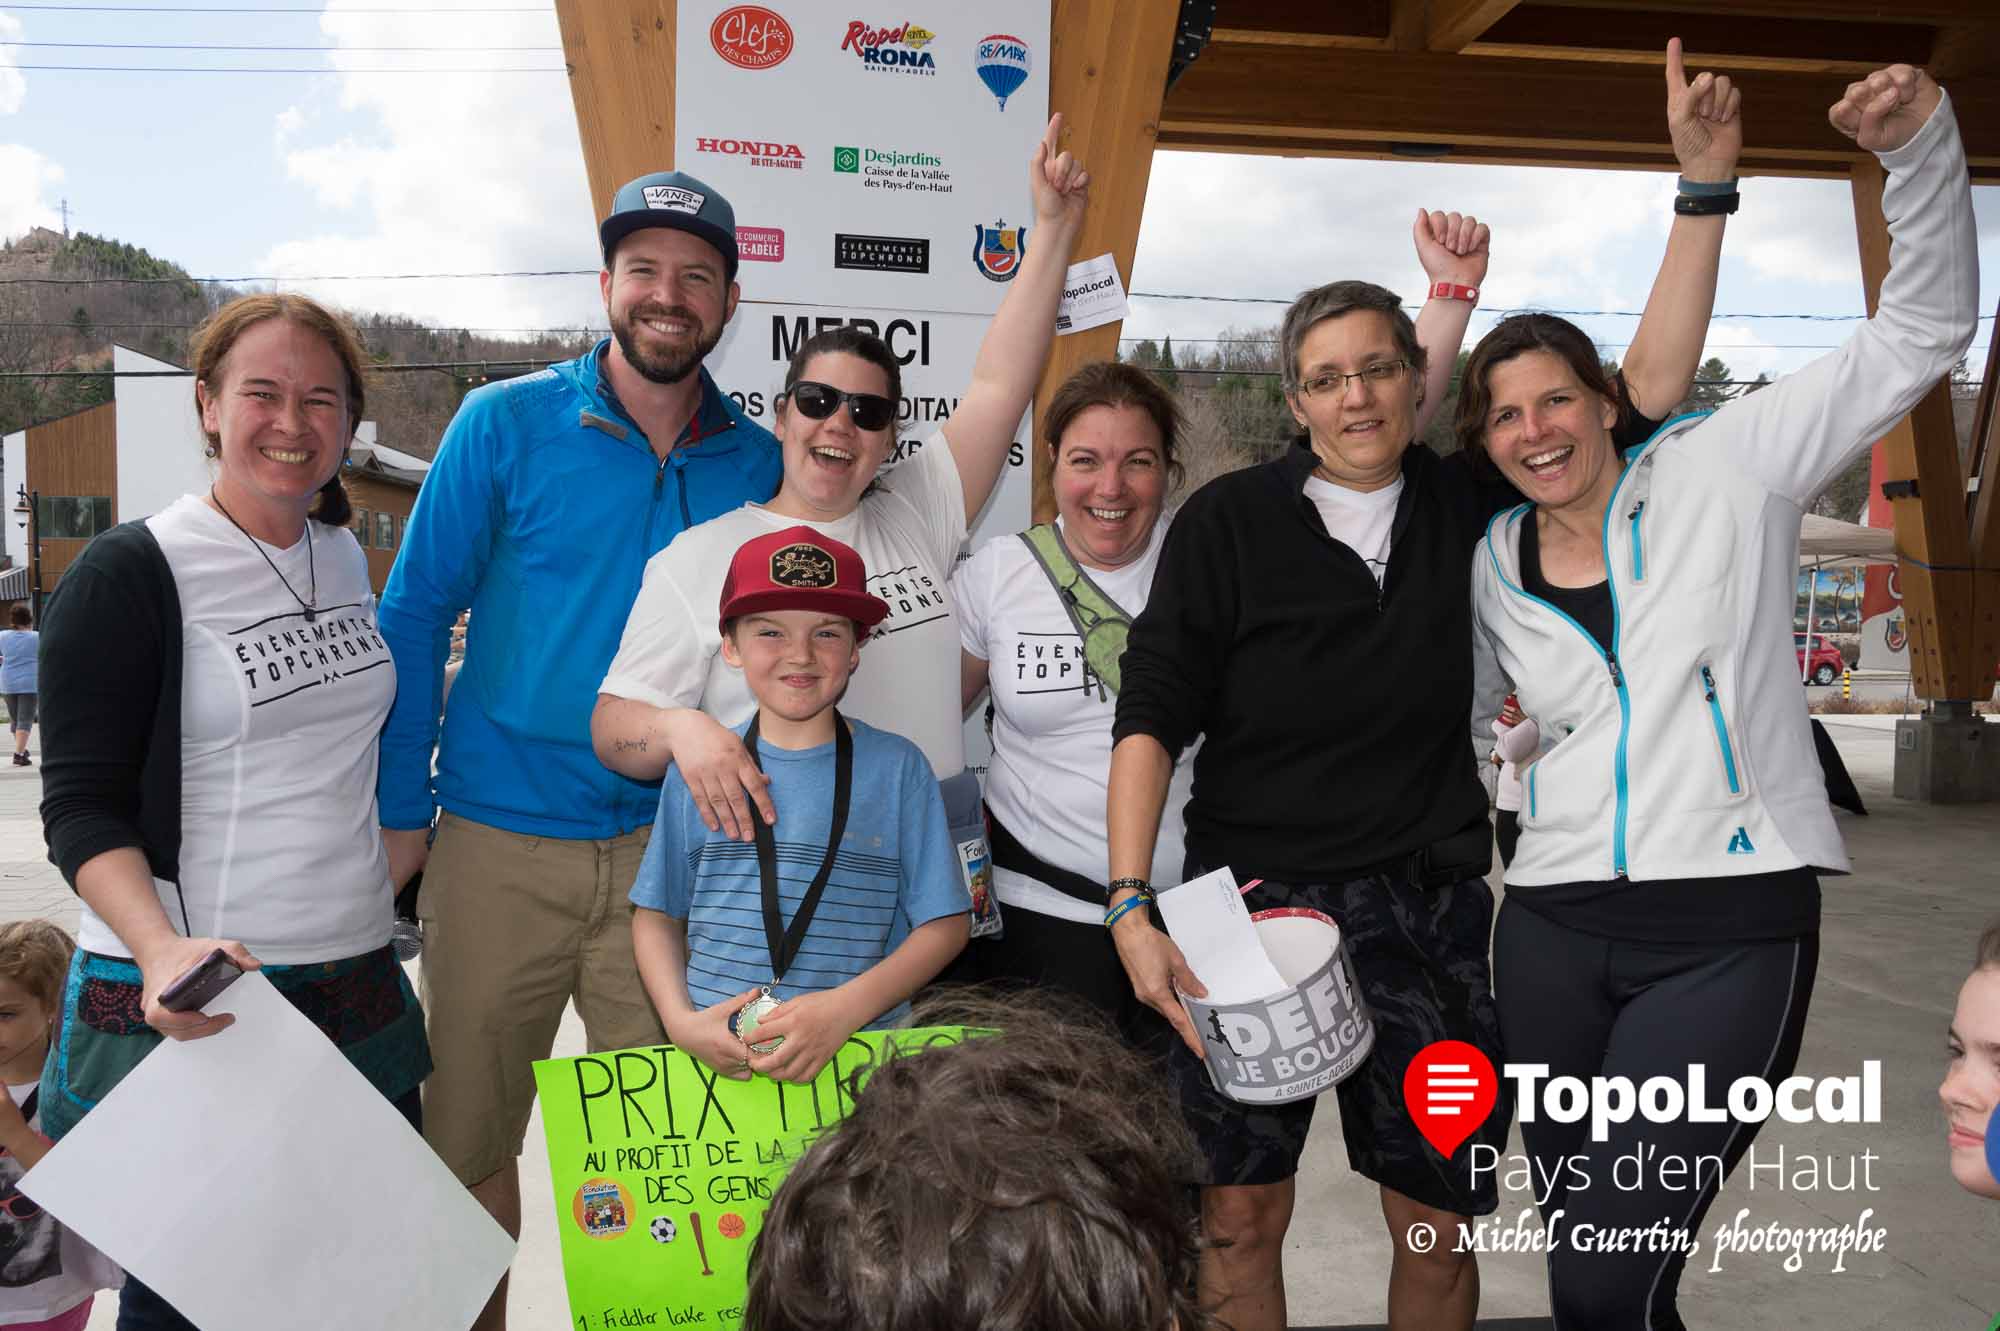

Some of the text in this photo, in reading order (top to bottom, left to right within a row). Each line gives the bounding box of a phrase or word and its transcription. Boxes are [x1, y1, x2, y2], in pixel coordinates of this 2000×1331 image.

[841, 20, 910, 57] Riopel
[721, 43, 783, 65] DES CHAMPS
[864, 47, 936, 69] RONA
[980, 42, 1026, 64] RE/MAX
[696, 138, 806, 160] HONDA
[864, 148, 942, 168] Desjardins
[864, 166, 951, 182] Caisse de la Vallée
[655, 188, 694, 203] VANS
[864, 178, 953, 194] des Pays-d'en-Haut
[744, 232, 780, 243] COMMERCE
[841, 250, 923, 265] TOPCHRONO
[244, 635, 385, 689] TOPCHRONO
[1236, 1006, 1364, 1083] JE BOUGE
[574, 1046, 735, 1144] PRIX
[584, 1146, 606, 1173] AU
[616, 1142, 692, 1173] PROFIT
[706, 1140, 744, 1168] DE
[755, 1138, 785, 1167] LA
[644, 1174, 773, 1206] DES GENS
[665, 1305, 706, 1327] lake
